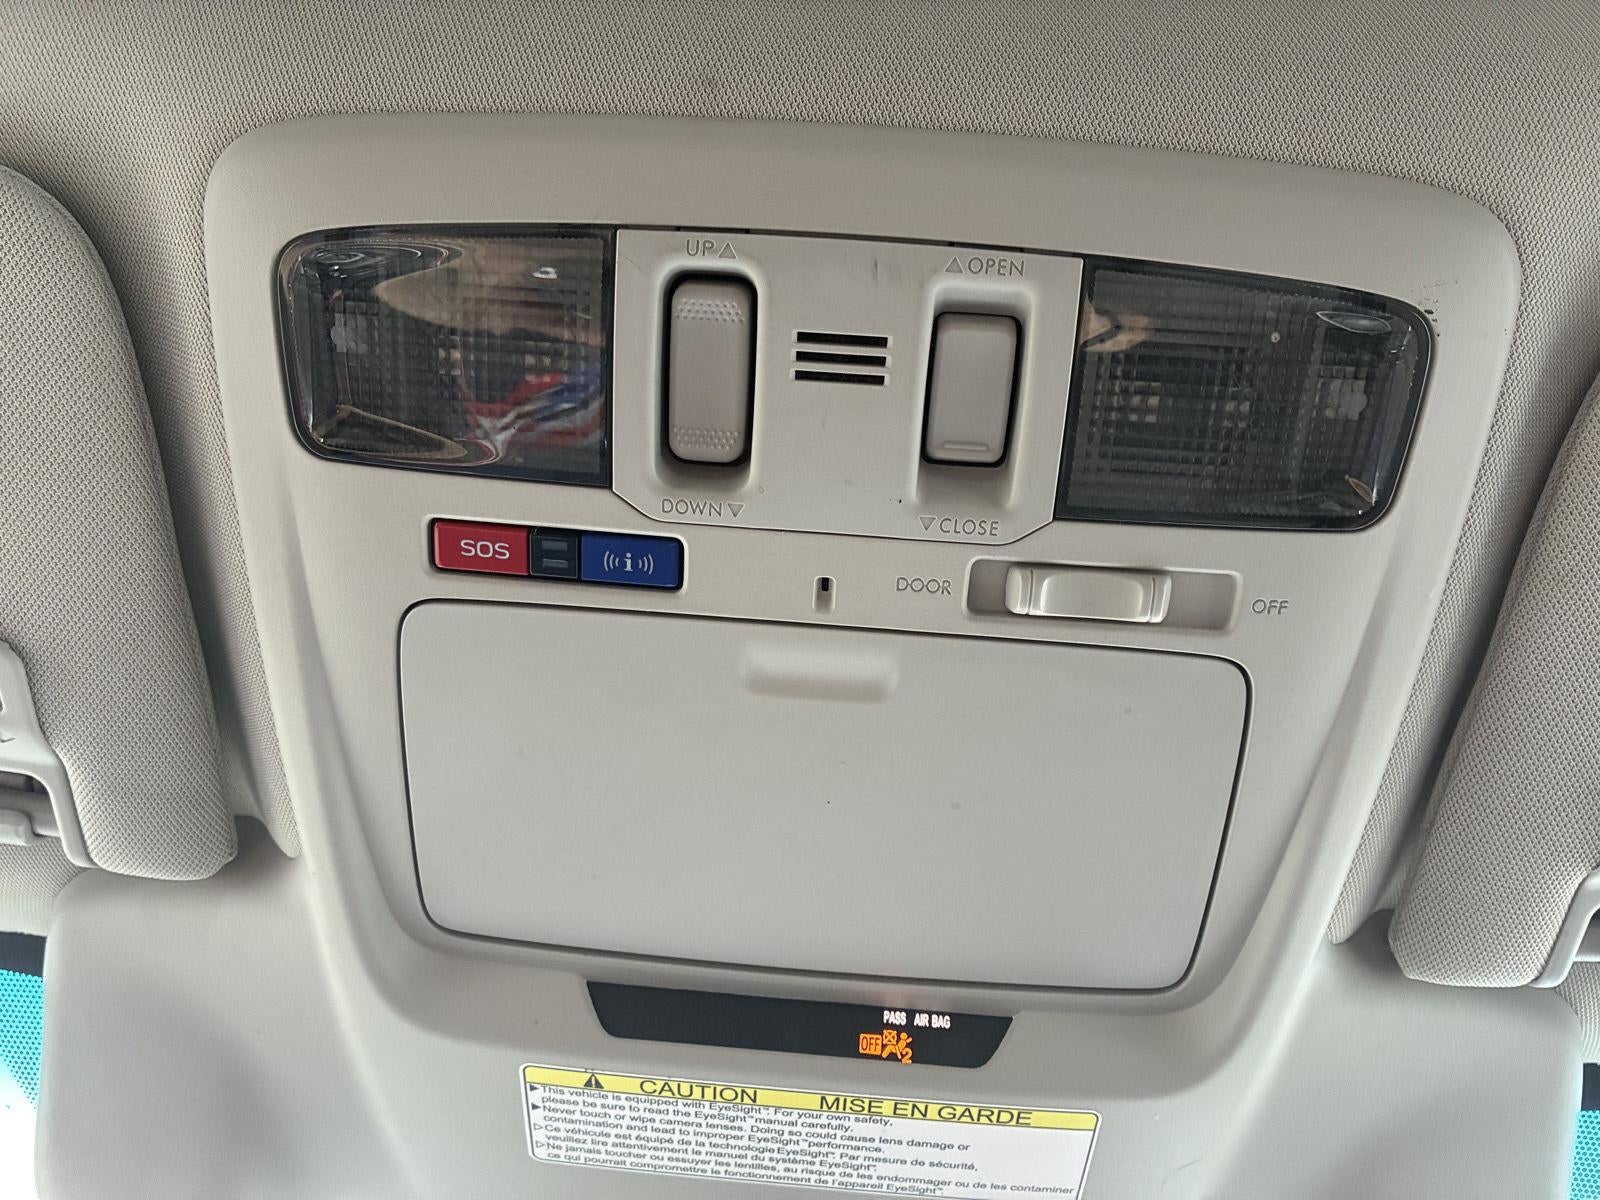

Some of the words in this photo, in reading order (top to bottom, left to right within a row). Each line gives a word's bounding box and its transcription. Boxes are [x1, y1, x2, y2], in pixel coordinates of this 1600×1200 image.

[685, 239, 716, 257] UP
[967, 256, 1025, 277] OPEN
[661, 498, 723, 518] DOWN
[939, 517, 1000, 537] CLOSE
[460, 539, 510, 560] SOS
[895, 576, 952, 596] DOOR
[1251, 598, 1289, 616] OFF
[883, 1010, 907, 1026] PASS
[913, 1013, 929, 1028] AIR
[931, 1014, 951, 1029] BAG
[861, 1036, 881, 1052] OFF
[542, 1085, 565, 1095] This
[569, 1089, 608, 1100] vehicle
[612, 1093, 622, 1101] is
[625, 1096, 678, 1108] equipped
[682, 1101, 705, 1109] with
[774, 1108, 794, 1117] For
[797, 1112, 823, 1120] your
[827, 1114, 850, 1122] own
[639, 1080, 758, 1104] CAUTION
[542, 1096, 579, 1106] please
[583, 1100, 597, 1108] be
[601, 1103, 625, 1111] sure
[644, 1106, 669, 1116] read
[673, 1109, 691, 1117] the
[755, 1117, 798, 1127] manual
[801, 1121, 854, 1132] carefully.
[820, 1096, 884, 1114] MISE
[893, 1102, 928, 1118] EN
[938, 1106, 1033, 1126] GARDE
[543, 1105, 577, 1115] Never
[580, 1109, 611, 1119] touch
[629, 1114, 656, 1125] wipe
[659, 1118, 702, 1128] camera
[751, 1125, 784, 1136] Doing
[805, 1132, 837, 1140] could
[840, 1135, 875, 1143] cause
[879, 1137, 903, 1146] lens
[907, 1139, 954, 1150] damage
[544, 1115, 622, 1130] contamination
[626, 1122, 647, 1132] and
[651, 1125, 675, 1135] lead
[679, 1128, 690, 1136] to
[693, 1128, 745, 1141] improper
[808, 1141, 885, 1154] performance.
[545, 1124, 561, 1132] Ce
[565, 1127, 611, 1138] véhicule
[636, 1132, 674, 1146] équipé
[678, 1138, 692, 1146] de
[709, 1141, 775, 1154] technologie
[840, 1152, 860, 1161] Par
[864, 1155, 907, 1165] mesure
[545, 1134, 587, 1145] veuillez
[591, 1138, 608, 1147] lire
[611, 1141, 689, 1155] attentivement
[692, 1148, 702, 1156] le
[705, 1150, 748, 1160] manuel
[751, 1154, 765, 1162] du
[546, 1142, 562, 1150] Ne
[565, 1144, 602, 1155] jamais
[604, 1149, 647, 1160] toucher
[668, 1156, 712, 1166] essuyer
[715, 1159, 731, 1167] les
[784, 1166, 797, 1174] au
[801, 1167, 836, 1177] risque
[840, 1170, 853, 1178] de
[857, 1172, 873, 1180] les
[876, 1174, 952, 1187] endommager
[955, 1180, 969, 1188] ou
[1010, 1184, 1075, 1194] contaminer
[564, 1154, 580, 1162] qui
[584, 1156, 627, 1167] pourrait
[629, 1160, 708, 1175] compromettre
[711, 1166, 721, 1175] le
[724, 1168, 812, 1184] fonctionnement
[814, 1177, 829, 1185] de
